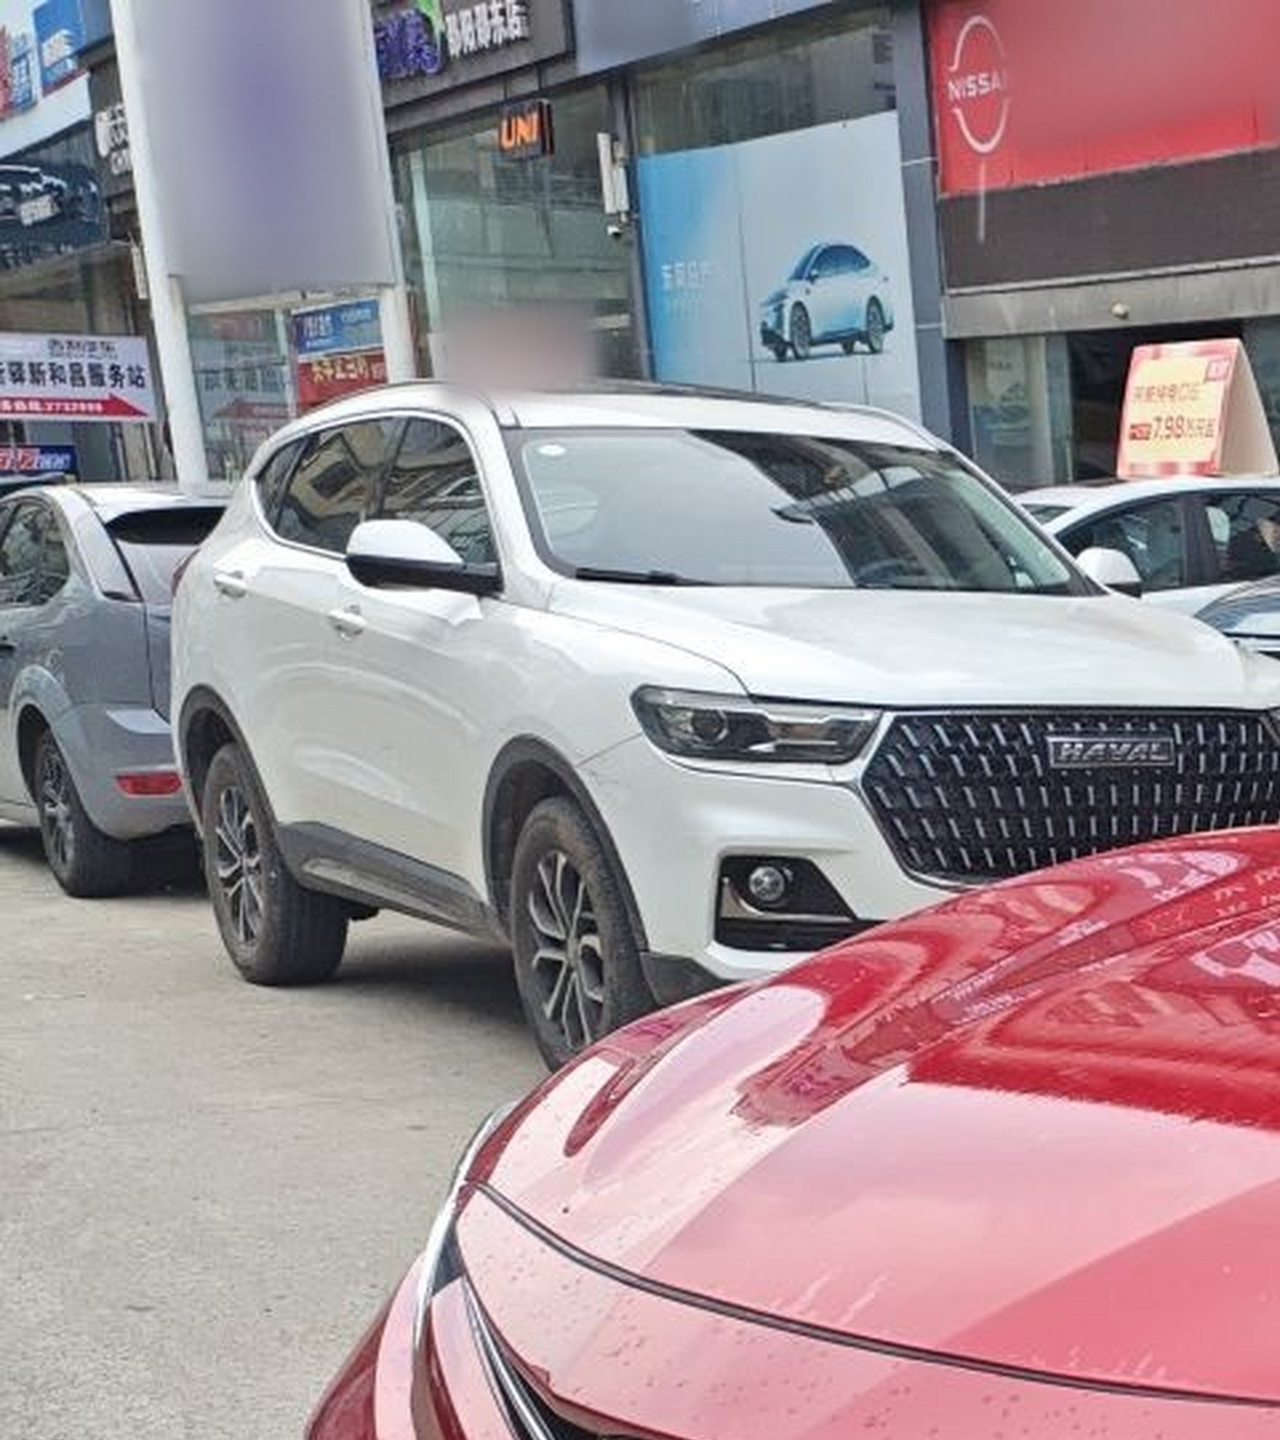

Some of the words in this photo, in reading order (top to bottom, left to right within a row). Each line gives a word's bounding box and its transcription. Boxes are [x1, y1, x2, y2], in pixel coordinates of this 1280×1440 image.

[948, 66, 1010, 103] NISSA
[501, 112, 539, 149] UNI
[1059, 742, 1169, 761] HAVAL
